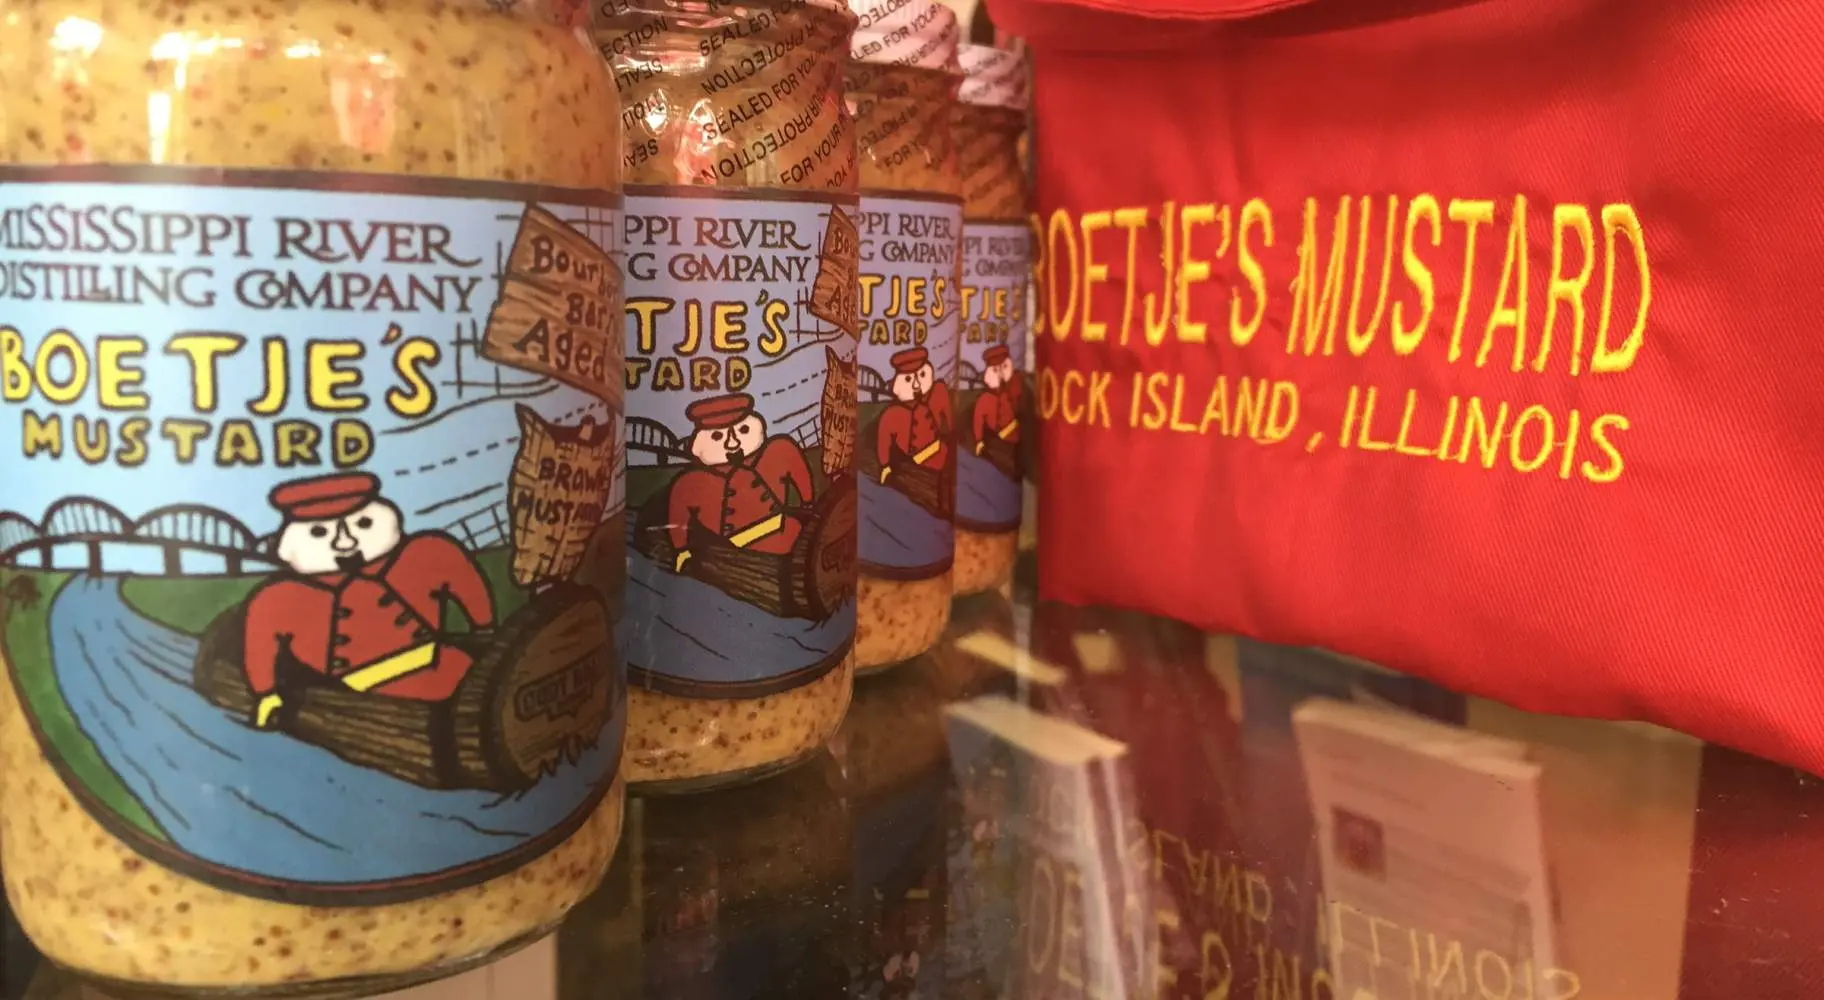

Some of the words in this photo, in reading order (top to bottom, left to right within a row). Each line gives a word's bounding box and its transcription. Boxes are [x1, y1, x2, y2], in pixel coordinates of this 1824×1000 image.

[703, 91, 774, 140] SEALED
[772, 73, 801, 101] FOR
[701, 112, 815, 182] PROTECTION
[780, 156, 815, 185] FOR
[275, 215, 482, 267] RIVER
[694, 215, 810, 250] RIVER
[898, 213, 956, 240] RIVER
[235, 269, 482, 314] COMPANY
[667, 253, 811, 283] COMPANY
[1287, 193, 1651, 375] MUSTARD
[0, 322, 442, 417] BOETJE'S
[512, 318, 607, 383] Aged
[22, 409, 375, 469] MUSTARD
[1036, 366, 1112, 429] OCK
[1340, 385, 1629, 483] ILLINOIS
